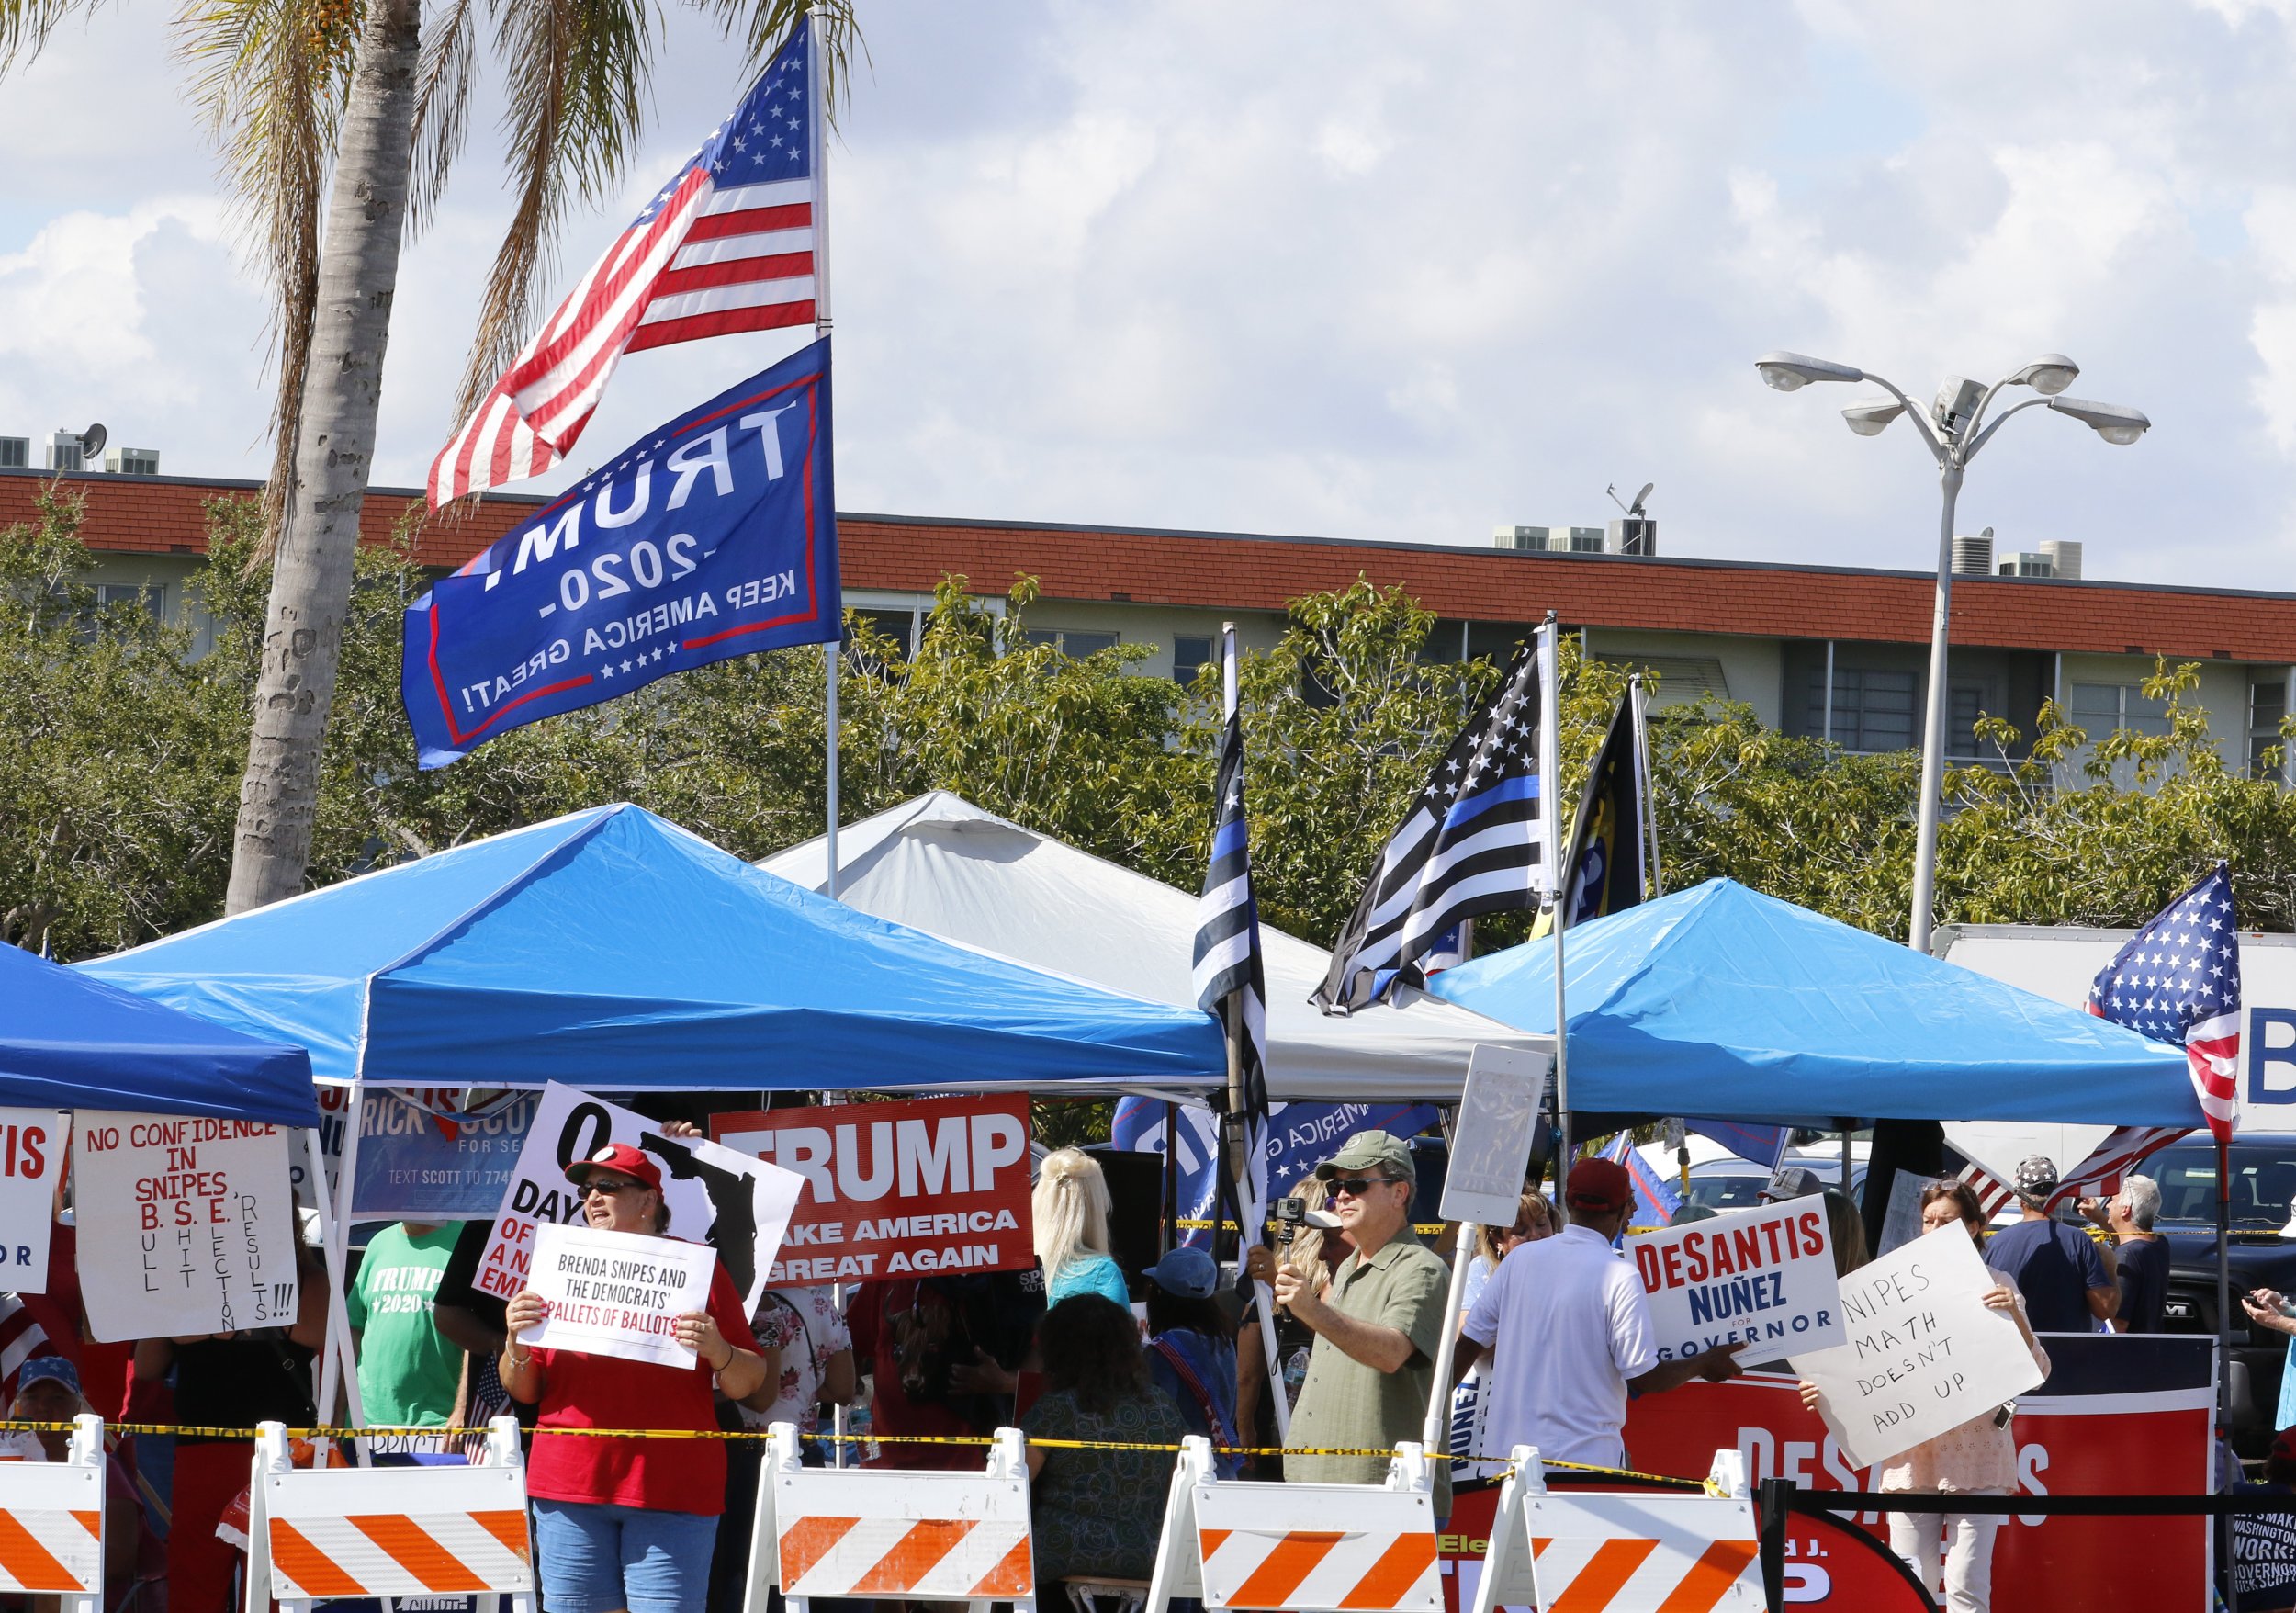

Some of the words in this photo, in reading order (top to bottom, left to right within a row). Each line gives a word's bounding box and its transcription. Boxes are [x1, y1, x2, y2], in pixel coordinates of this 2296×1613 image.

[360, 1096, 425, 1137] RICK
[87, 1127, 119, 1152] NO
[130, 1118, 277, 1147] CONFIDENCE
[459, 1139, 490, 1153] FOR
[501, 1139, 526, 1153] SE
[167, 1146, 197, 1172] IN
[389, 1169, 418, 1184] TEXT
[422, 1169, 461, 1184] SCOTT
[466, 1169, 480, 1185] TO
[511, 1178, 590, 1227] DAY
[501, 1217, 535, 1244] OF
[780, 1222, 844, 1246] AKE
[852, 1209, 1019, 1241] AMERICA
[488, 1243, 505, 1266] A
[557, 1254, 607, 1278] BRENDA
[611, 1260, 657, 1283] SNIPES
[658, 1268, 687, 1289] AND
[766, 1253, 879, 1283] GREAT
[887, 1244, 999, 1273] AGAIN
[372, 1266, 445, 1292] TRUMP
[566, 1278, 590, 1299] THE
[1841, 1264, 1930, 1324] NIPES
[380, 1293, 422, 1314] 2020
[546, 1301, 600, 1325] PALLETS
[602, 1308, 619, 1326] OF
[1688, 1271, 1787, 1325] NUÑEZ
[1657, 1310, 1832, 1361] GOVERNOR
[1732, 1317, 1752, 1328] FOR
[1855, 1311, 1936, 1359] MATH
[1855, 1337, 1953, 1396] DOESN'T
[1874, 1402, 1915, 1433] ADD
[1934, 1372, 1964, 1398] UP
[2265, 1513, 2296, 1530] MAK
